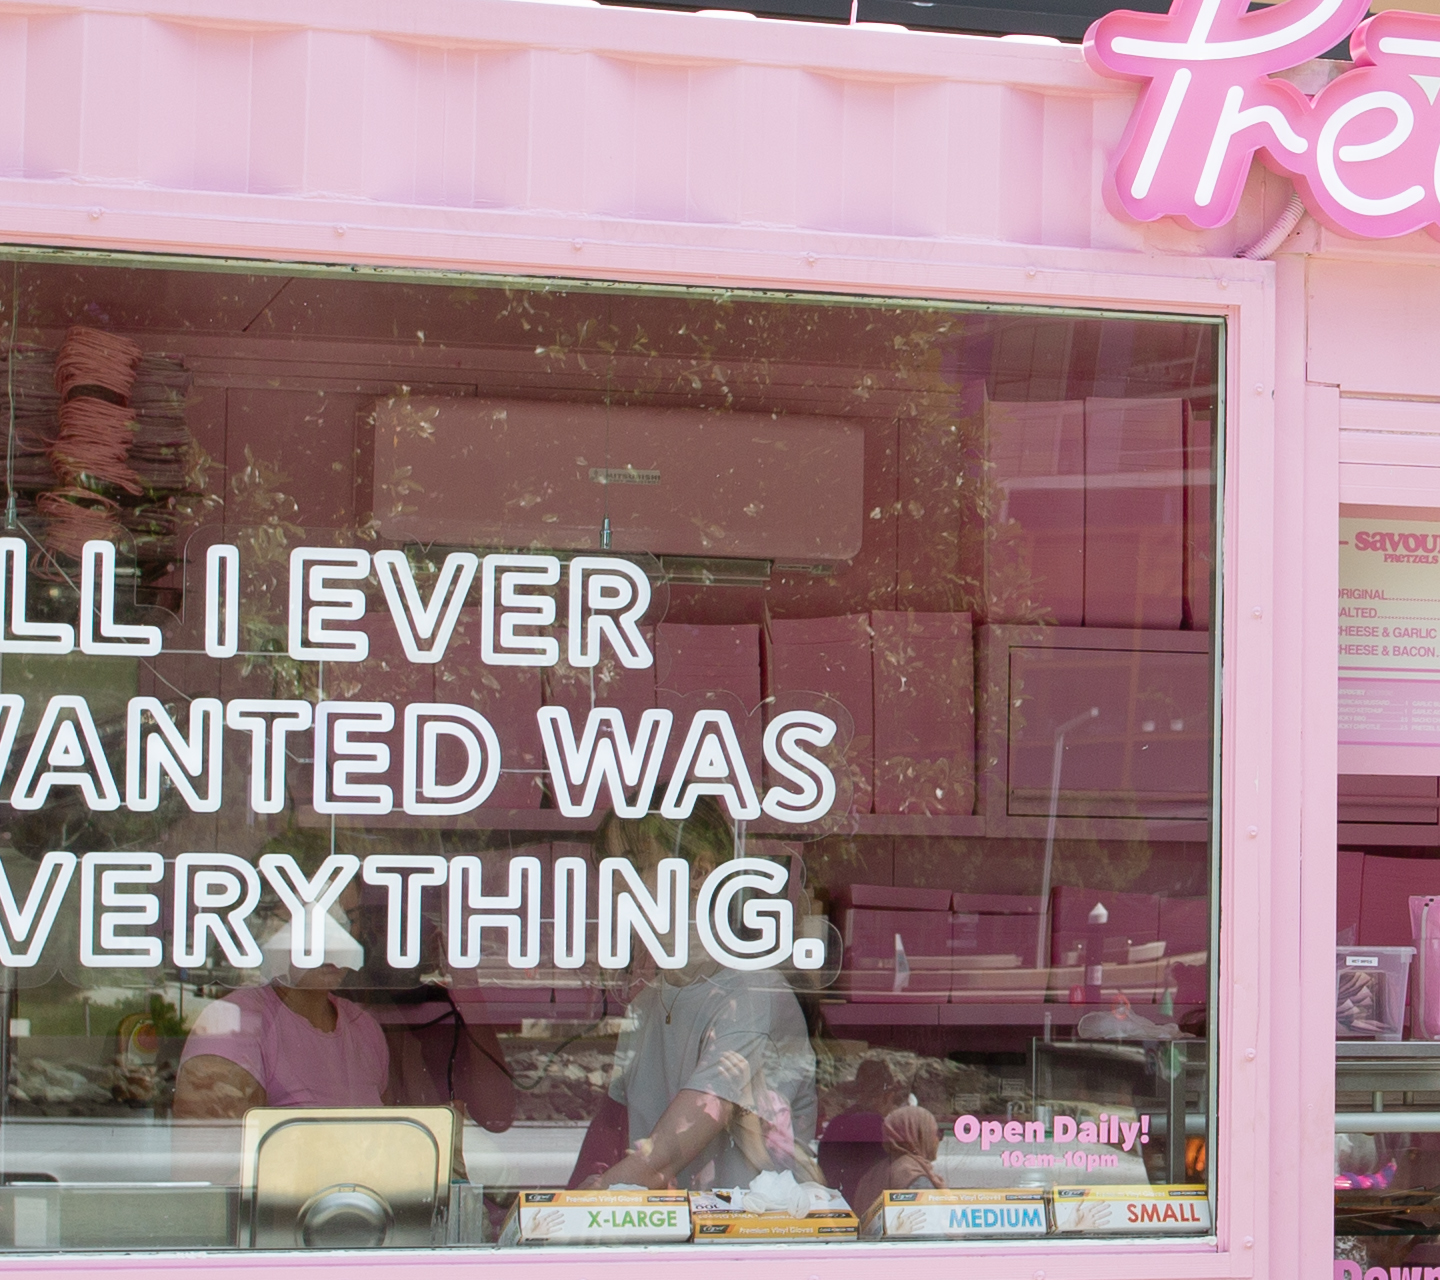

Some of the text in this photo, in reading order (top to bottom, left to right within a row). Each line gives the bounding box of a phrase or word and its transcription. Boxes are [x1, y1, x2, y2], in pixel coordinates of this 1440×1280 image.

[206, 544, 239, 658] I
[289, 547, 654, 669] EVER
[1338, 626, 1379, 638] HEESE
[1382, 628, 1390, 638] &
[1393, 628, 1437, 639] GARLIC
[1338, 645, 1378, 656] HEESE
[1382, 646, 1390, 656] &
[1393, 646, 1435, 658] BACON
[539, 705, 838, 823] WAS
[954, 1113, 1150, 1151] Open Daily!
[1001, 1150, 1118, 1171] 10am-10pm
[587, 1210, 677, 1228] X-LARGE
[949, 1209, 1042, 1228] MEDIUM
[1127, 1203, 1201, 1223] SMALL
